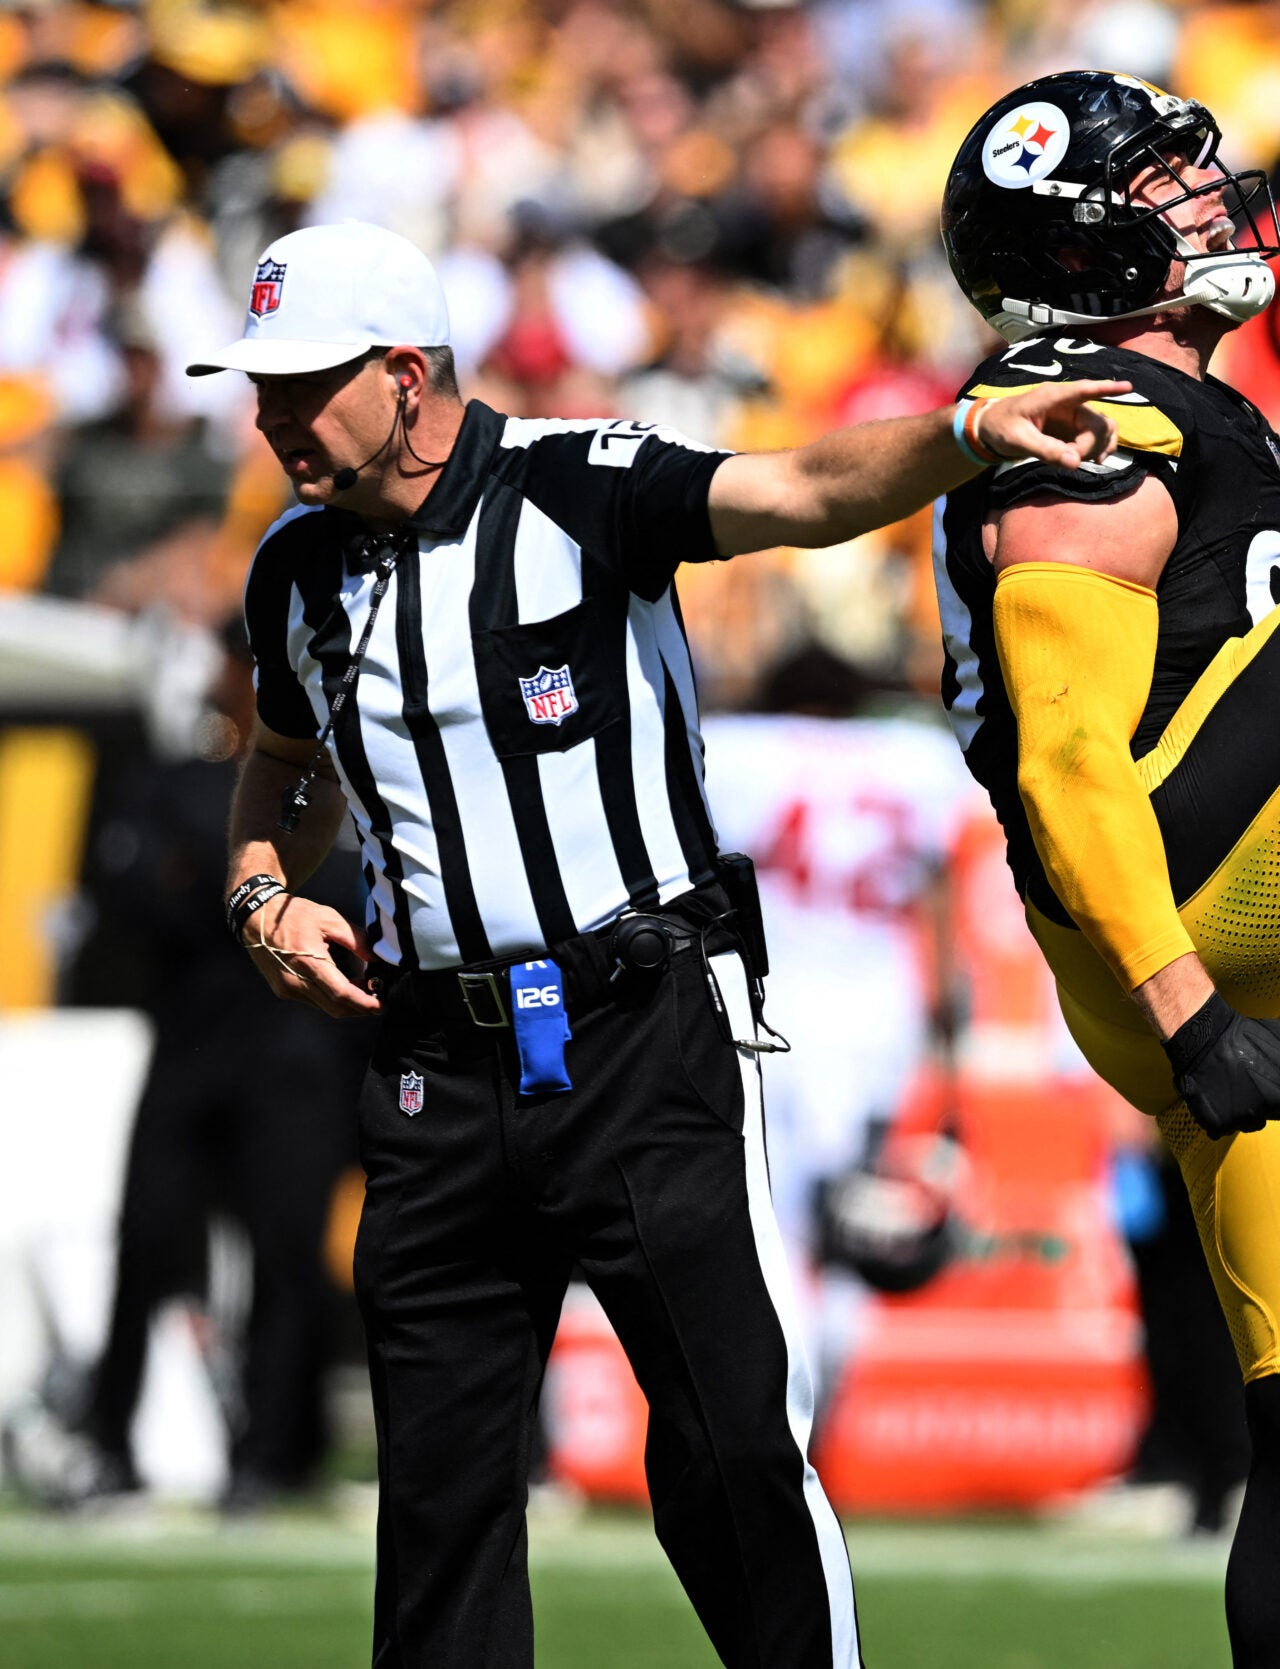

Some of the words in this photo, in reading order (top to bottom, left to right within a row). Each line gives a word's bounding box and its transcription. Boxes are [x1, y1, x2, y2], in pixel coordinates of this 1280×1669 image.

[992, 141, 1020, 158] Steelers
[530, 690, 572, 719] NFL
[247, 900, 260, 911] In
[516, 985, 560, 1009] 126
